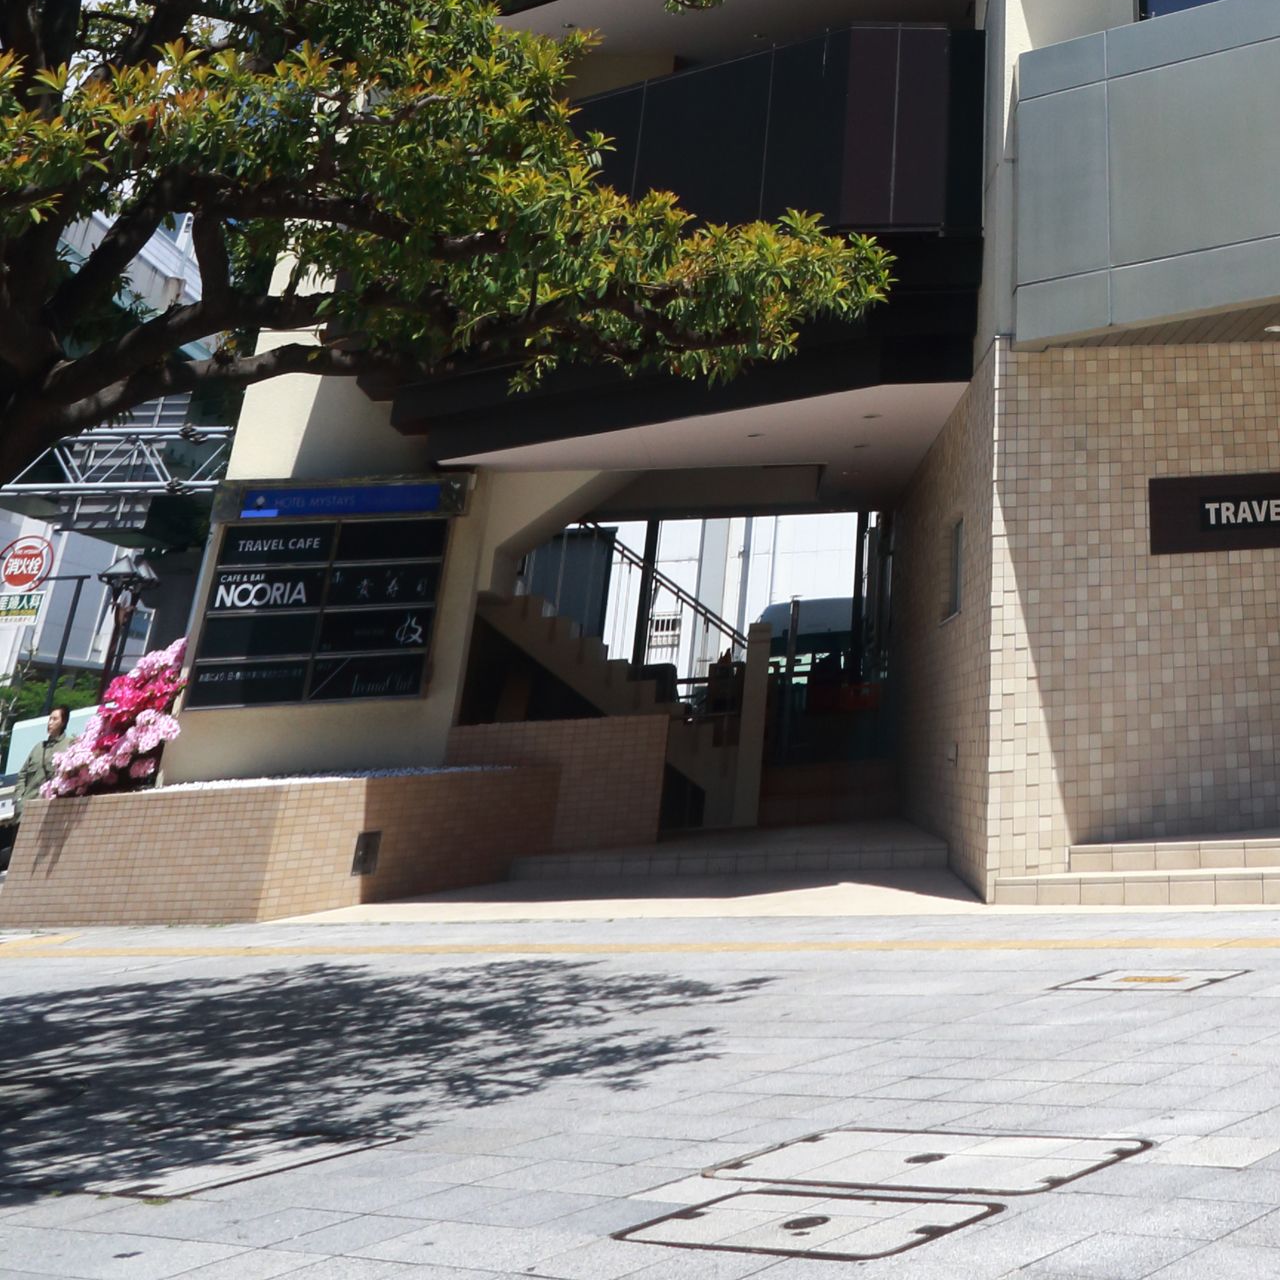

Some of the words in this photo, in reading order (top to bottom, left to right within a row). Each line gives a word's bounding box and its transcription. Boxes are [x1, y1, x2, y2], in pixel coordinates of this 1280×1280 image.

[310, 495, 355, 506] MYSTAYS
[238, 539, 285, 552] TRAVEL
[288, 537, 320, 550] CAFE
[5, 557, 42, 575] 消火栓
[220, 574, 241, 583] CAFE
